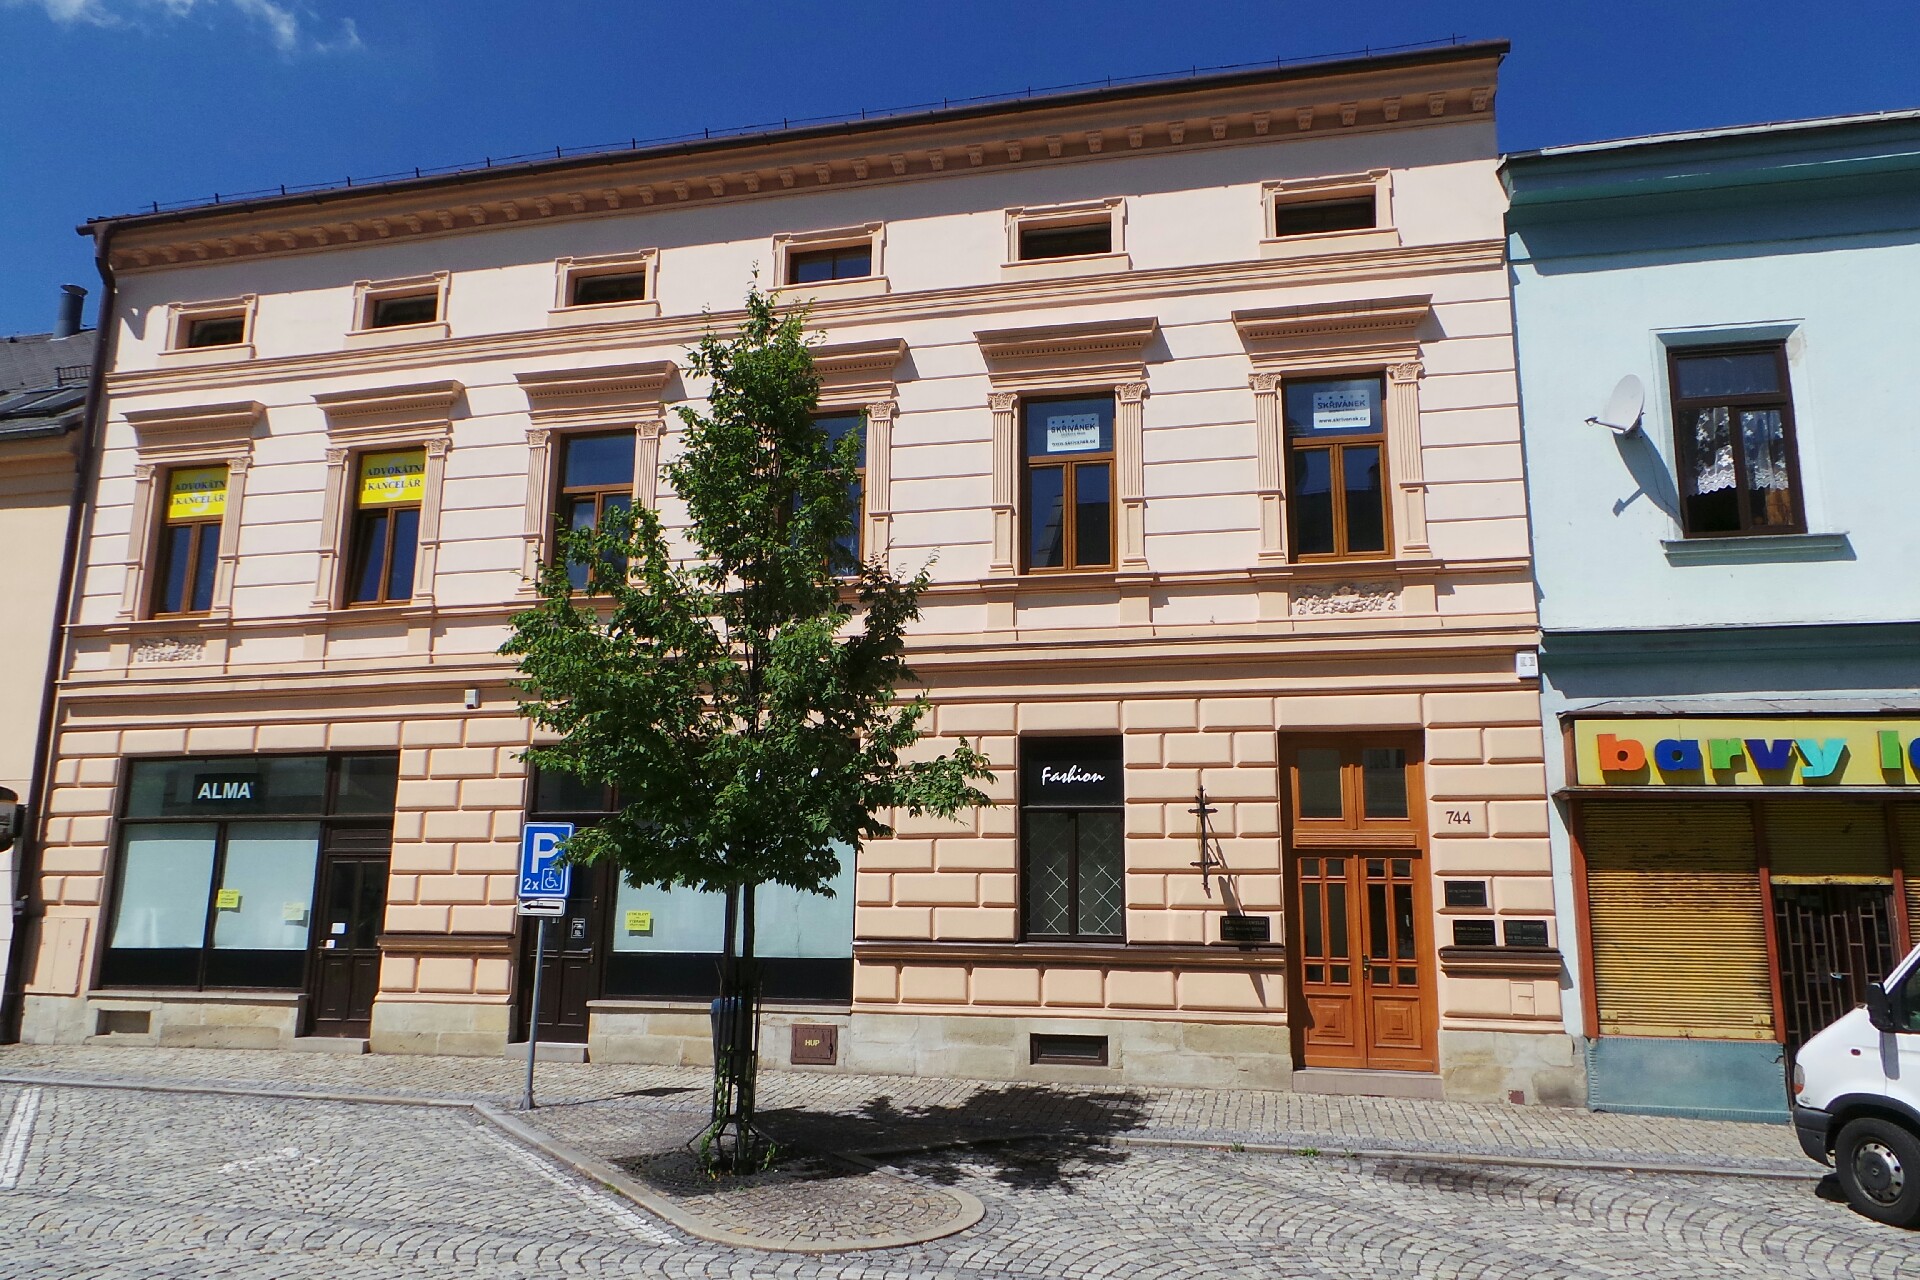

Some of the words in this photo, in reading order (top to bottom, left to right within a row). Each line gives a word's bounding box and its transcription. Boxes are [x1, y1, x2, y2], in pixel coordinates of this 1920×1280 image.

[1051, 422, 1096, 434] SKŘIVÁNEK
[176, 480, 226, 490] ADVOKÁTN
[1596, 733, 1847, 777] barvy
[1878, 731, 1920, 770] l
[1042, 765, 1105, 786] Fashion
[197, 782, 251, 799] ALMA
[1445, 810, 1471, 824] 744
[531, 832, 560, 874] P
[524, 878, 539, 890] 2x
